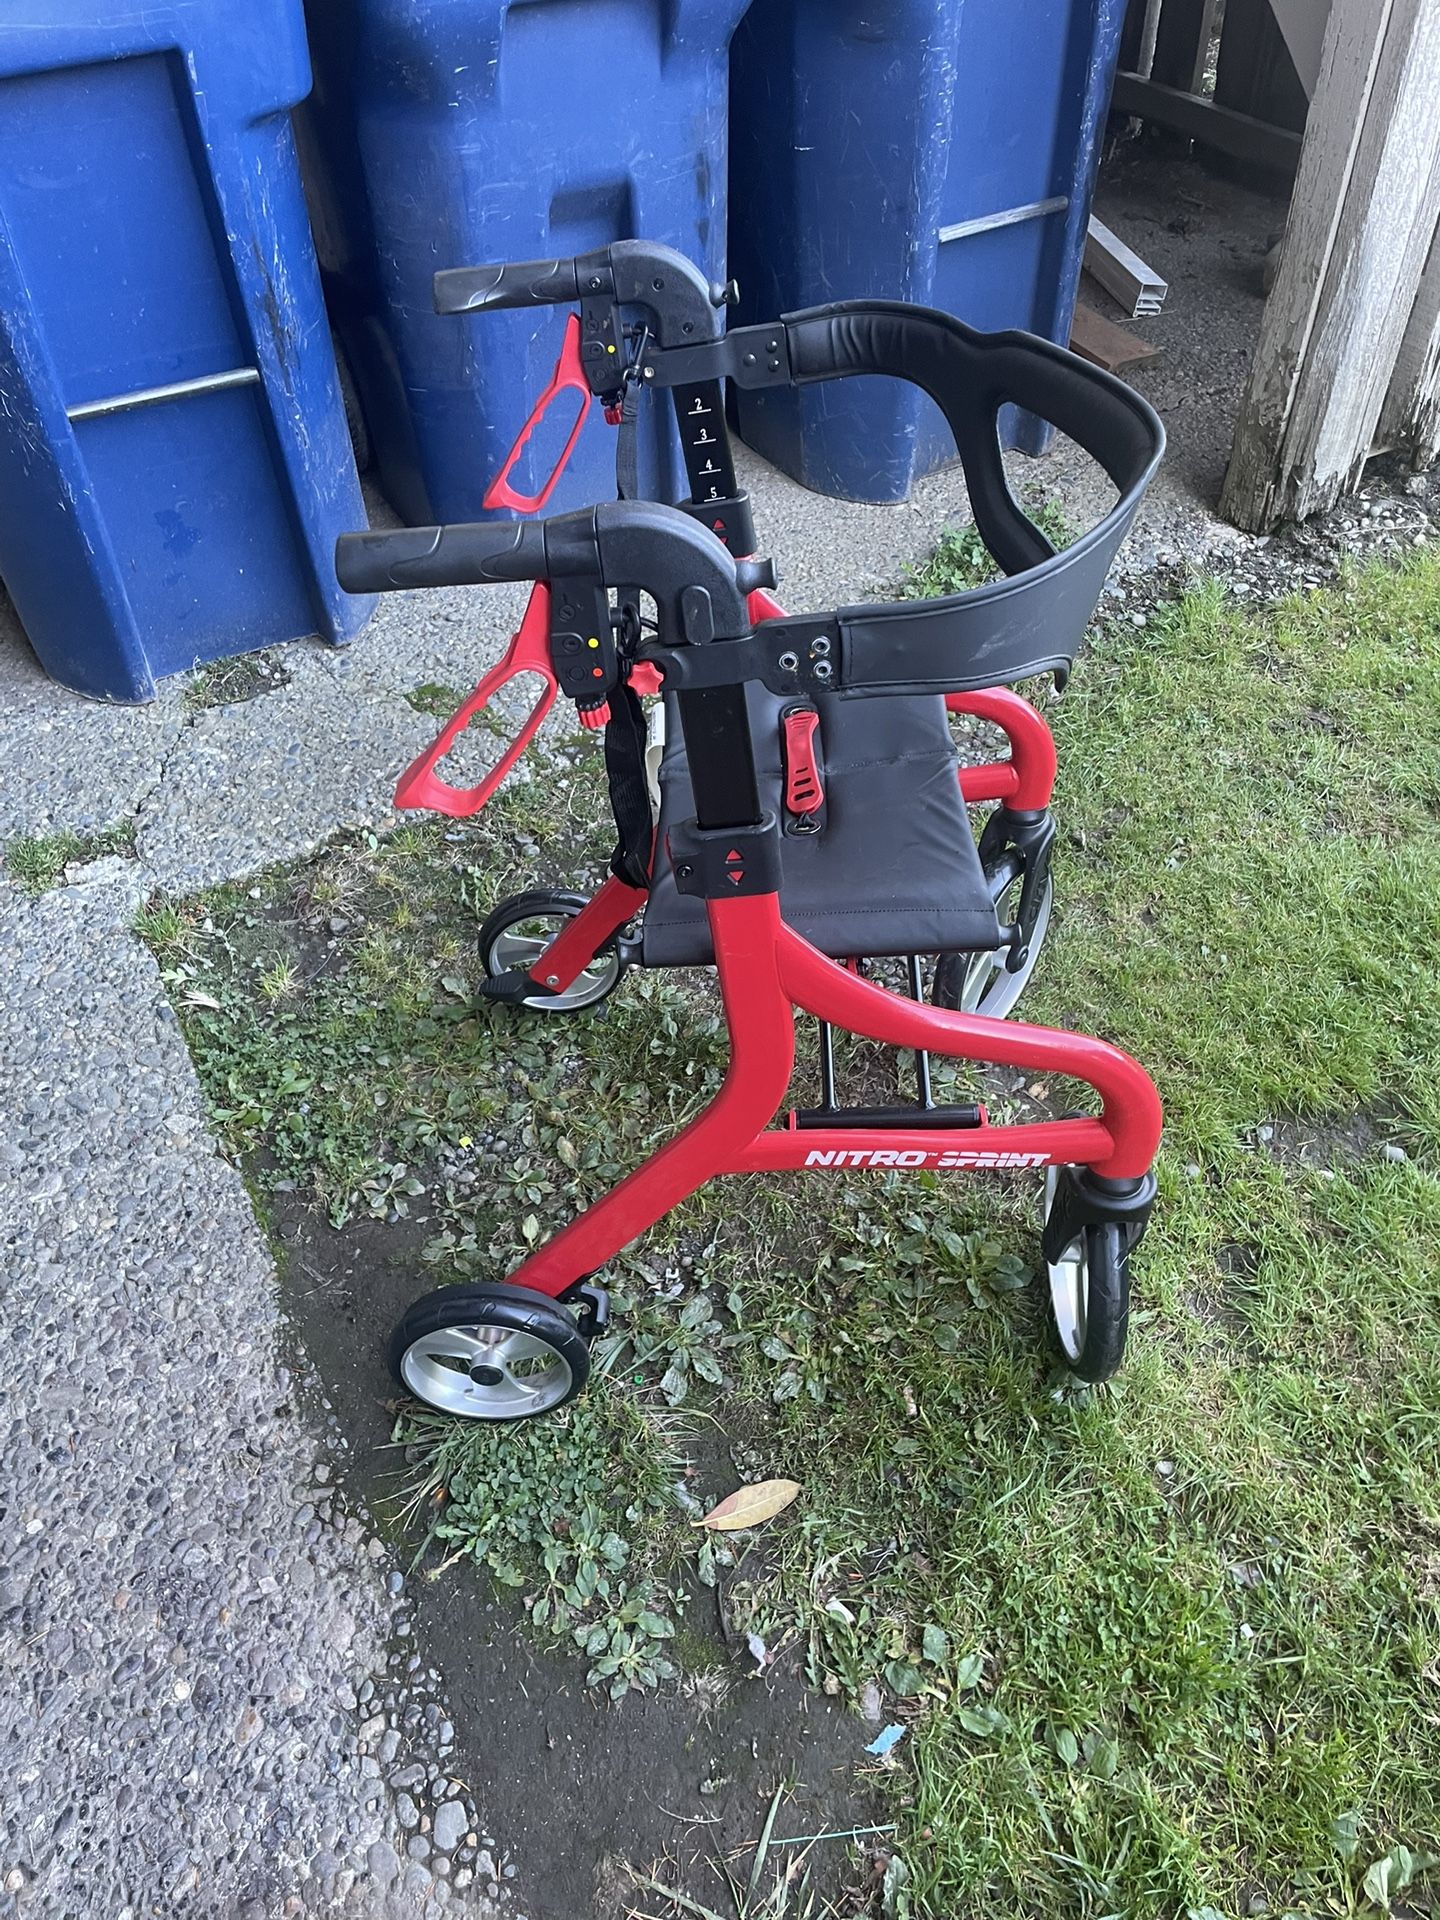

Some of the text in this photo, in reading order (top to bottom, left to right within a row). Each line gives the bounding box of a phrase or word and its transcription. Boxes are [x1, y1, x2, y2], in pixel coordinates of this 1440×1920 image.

[694, 397, 703, 410] 2
[700, 428, 707, 440] 3
[705, 459, 713, 470] 4
[710, 487, 717, 499] 5
[938, 1151, 1051, 1168] SPRINT
